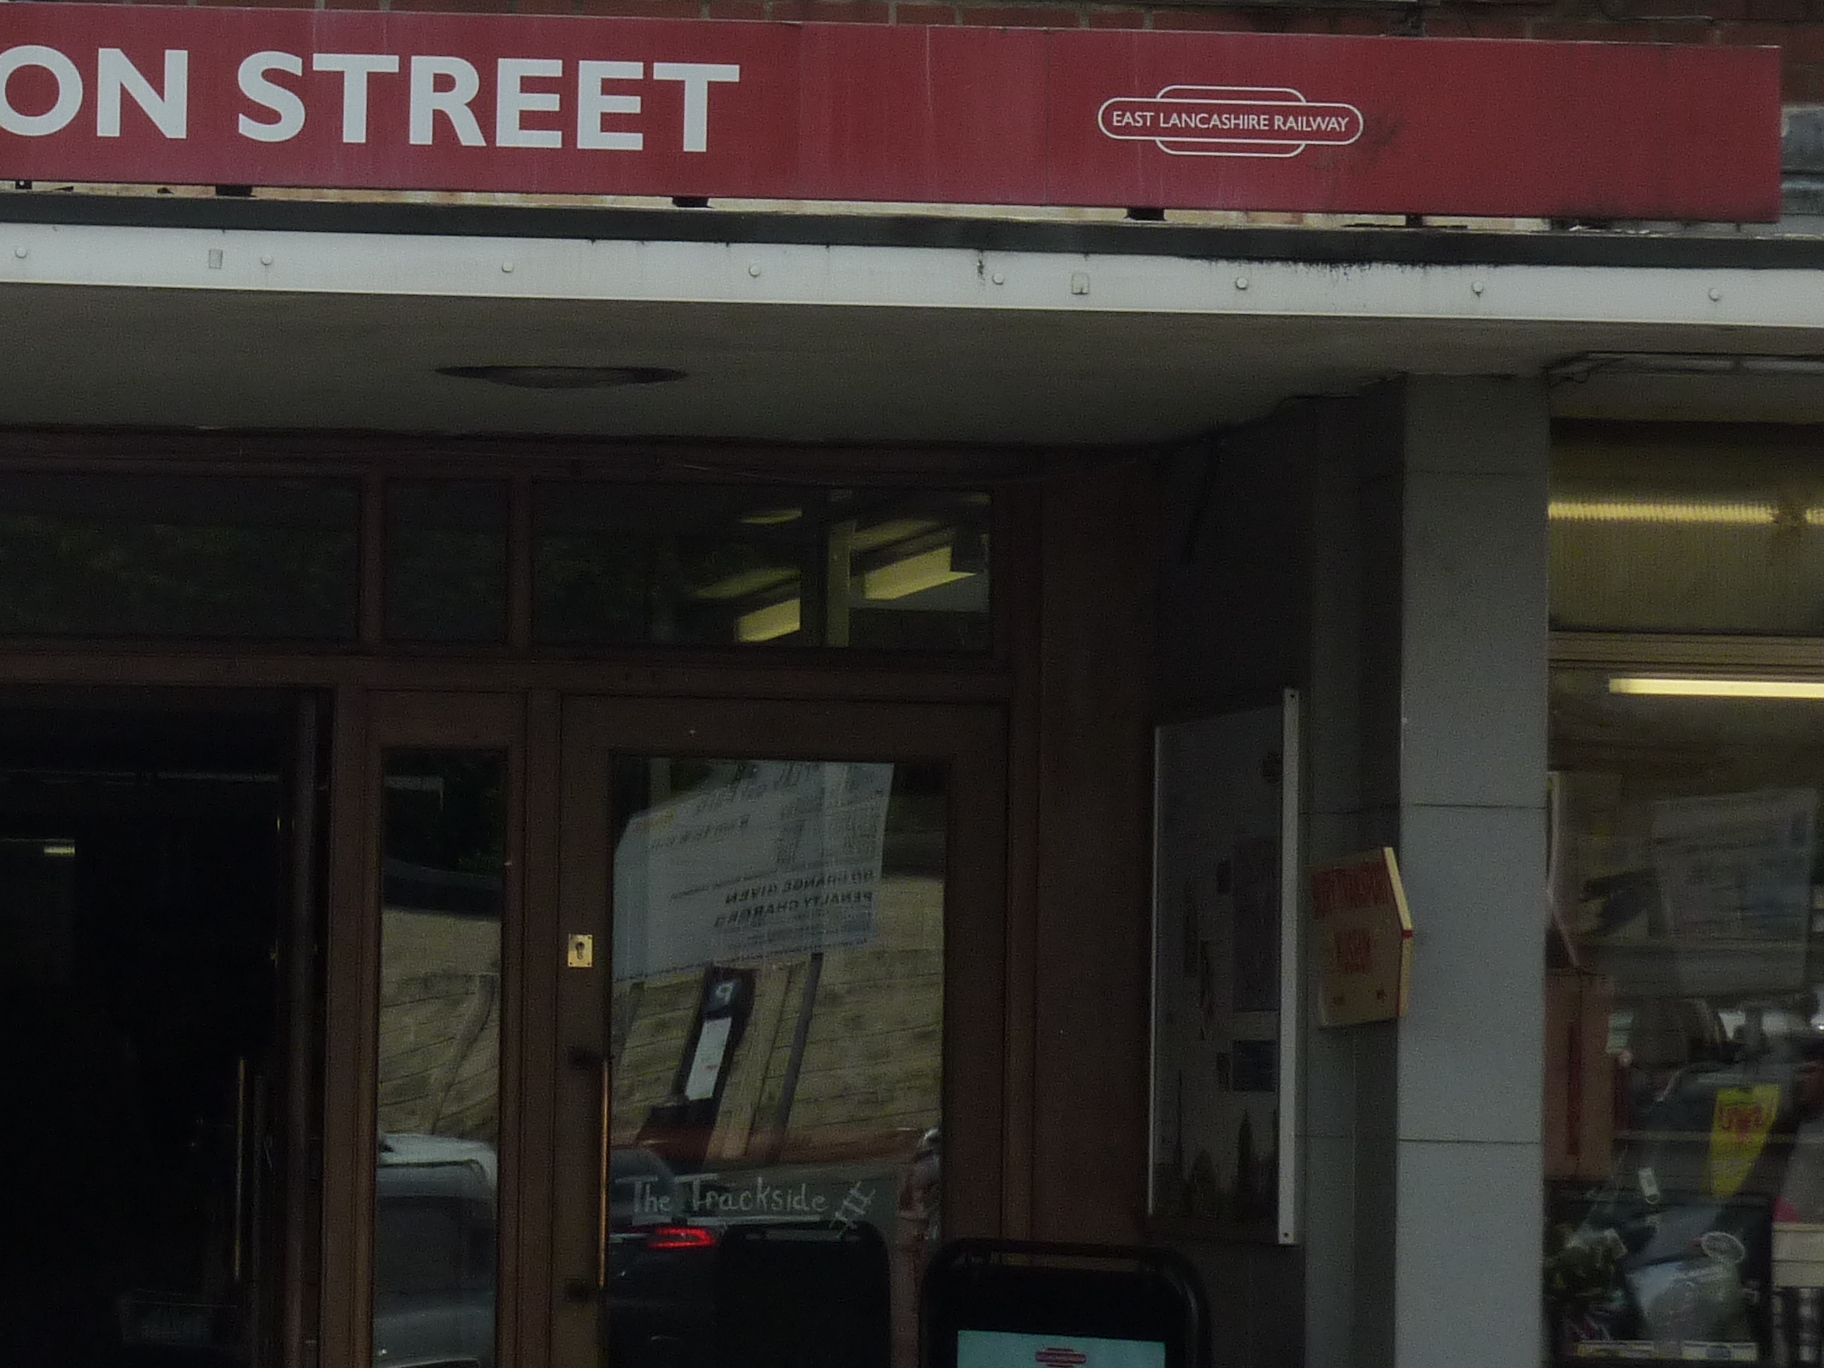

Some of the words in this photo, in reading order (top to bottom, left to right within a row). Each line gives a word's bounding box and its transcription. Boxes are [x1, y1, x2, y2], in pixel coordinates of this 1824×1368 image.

[236, 50, 741, 153] STREET
[1112, 111, 1155, 127] EAST
[1160, 113, 1270, 130] LANCASHIRE
[1274, 116, 1349, 132] RAILWAY
[616, 1175, 673, 1212] The
[676, 1173, 828, 1213] Trackside
